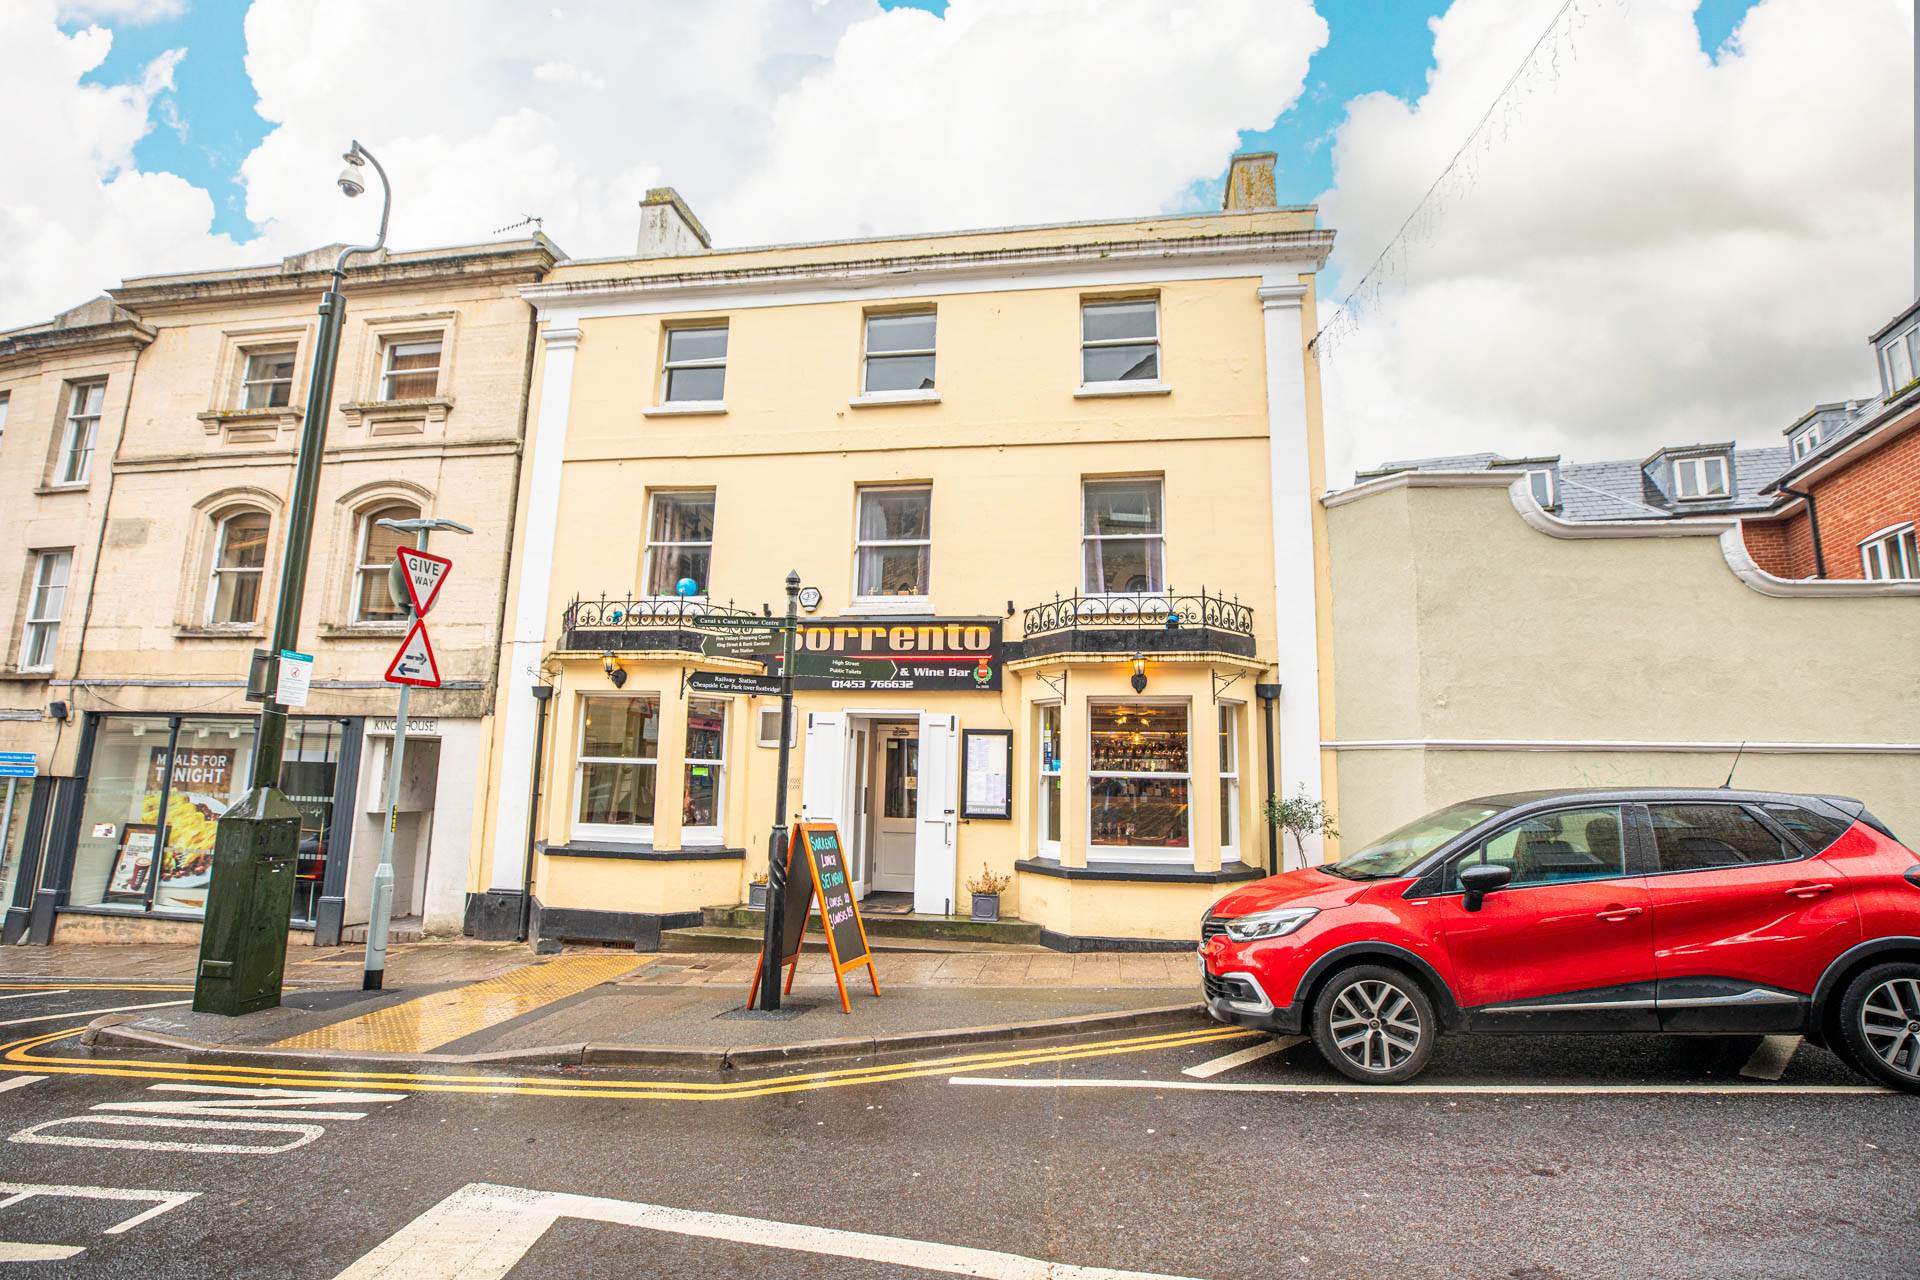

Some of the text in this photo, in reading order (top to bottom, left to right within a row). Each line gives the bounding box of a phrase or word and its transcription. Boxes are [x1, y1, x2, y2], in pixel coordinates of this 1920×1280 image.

[408, 558, 439, 577] GIVE
[414, 575, 434, 588] WAY
[900, 667, 971, 677] & Wine Bar
[692, 680, 719, 689] Cheapside
[714, 675, 757, 685] Railway Station
[832, 680, 914, 689] 01453 766632
[156, 753, 227, 767] MALS FOR
[155, 766, 225, 784] TNIGHT
[821, 873, 831, 889] SET
